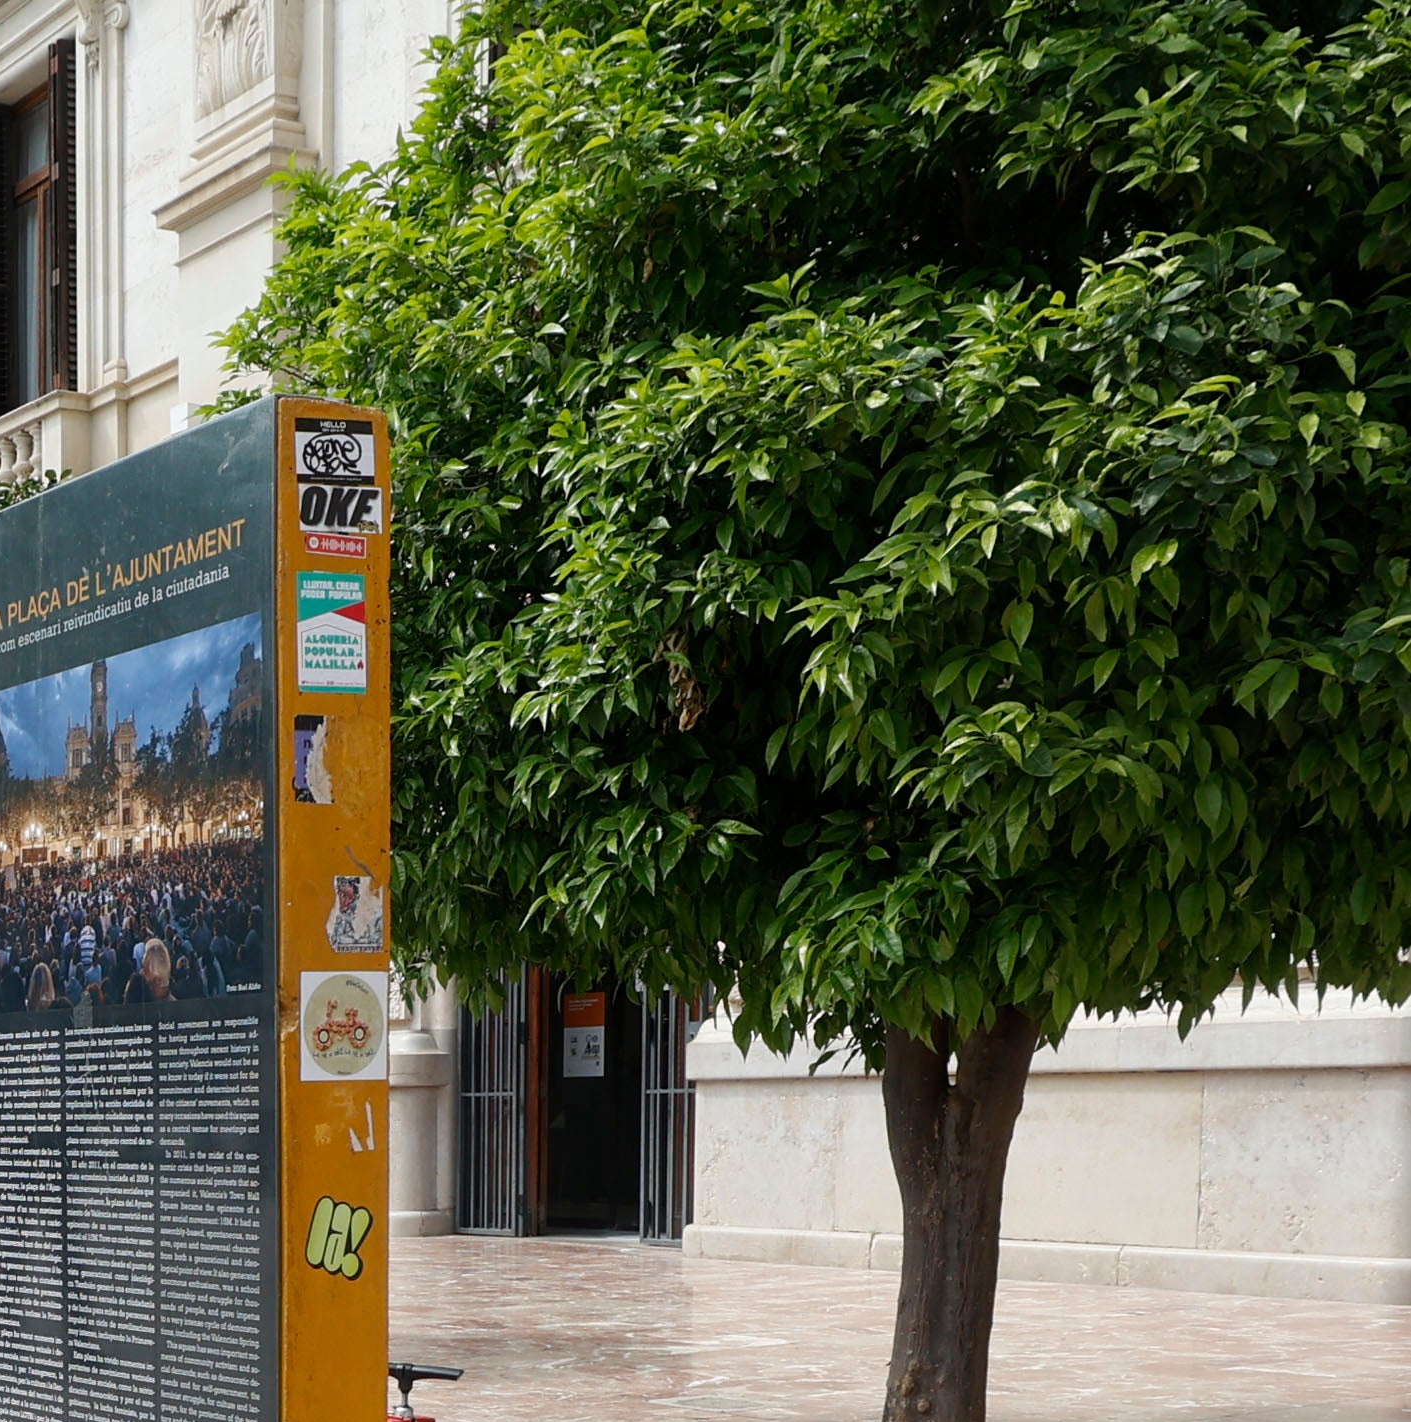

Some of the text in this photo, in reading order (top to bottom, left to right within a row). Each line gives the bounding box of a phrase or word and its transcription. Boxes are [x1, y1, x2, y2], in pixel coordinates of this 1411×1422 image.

[320, 421, 346, 429] HELLO
[8, 588, 61, 627] PLAÇA
[67, 576, 90, 606] DE
[95, 519, 245, 597] L'AJUNTAMENT
[329, 591, 362, 600] POPULAR
[18, 619, 61, 645] escenari
[63, 599, 131, 632] reivindicatiu
[134, 591, 149, 606] de
[152, 587, 163, 602] la
[166, 564, 229, 598] ciutadania
[304, 634, 359, 645] ALQUERIA
[304, 646, 355, 657] POPULAR
[304, 658, 357, 670] MALILLA
